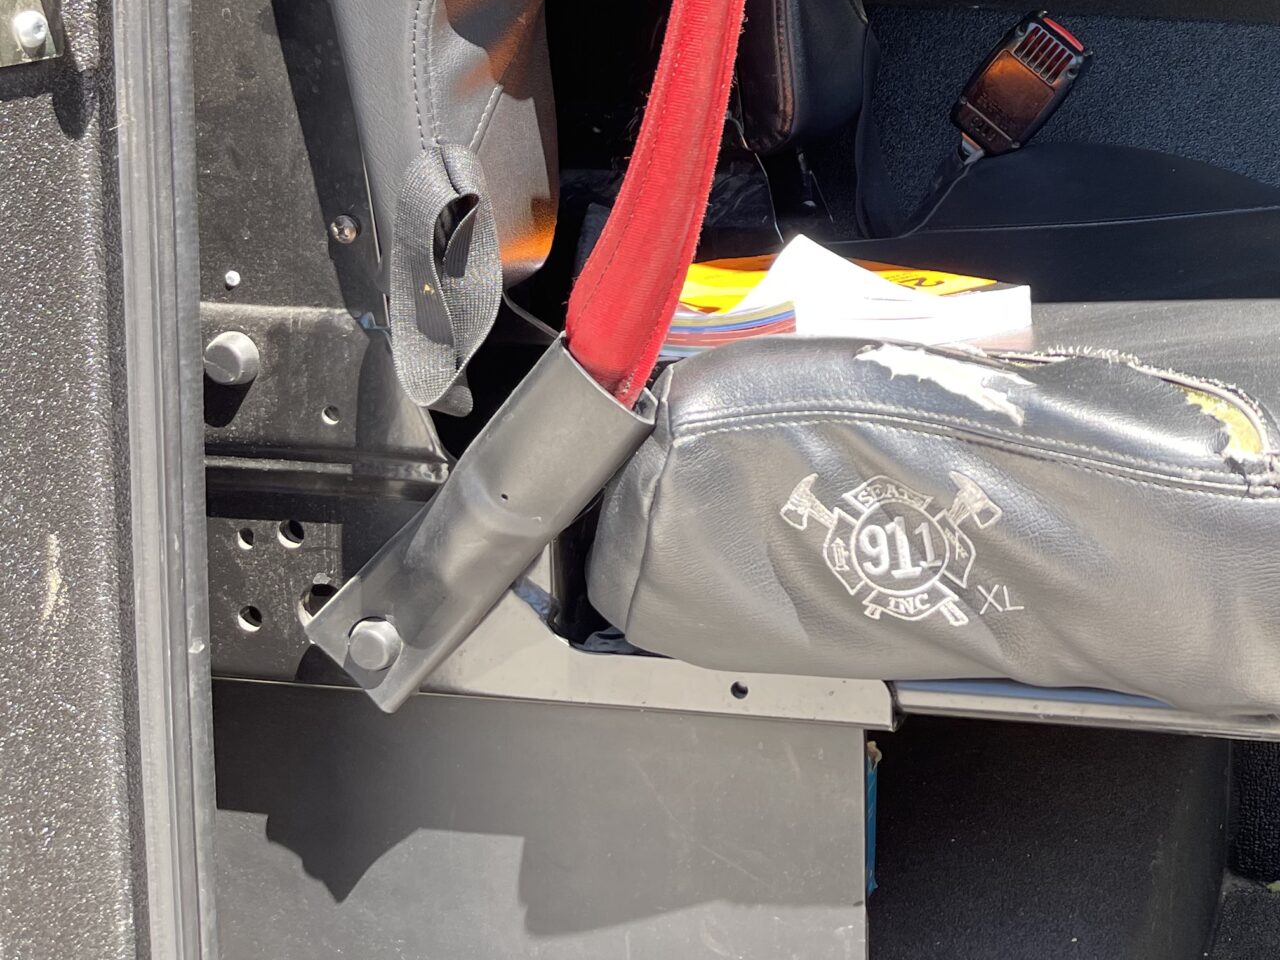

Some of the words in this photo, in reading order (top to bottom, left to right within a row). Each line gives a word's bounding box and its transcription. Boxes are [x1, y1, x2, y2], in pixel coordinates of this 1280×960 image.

[859, 516, 942, 579] 911
[887, 594, 931, 614] INC
[977, 584, 1025, 615] XL
